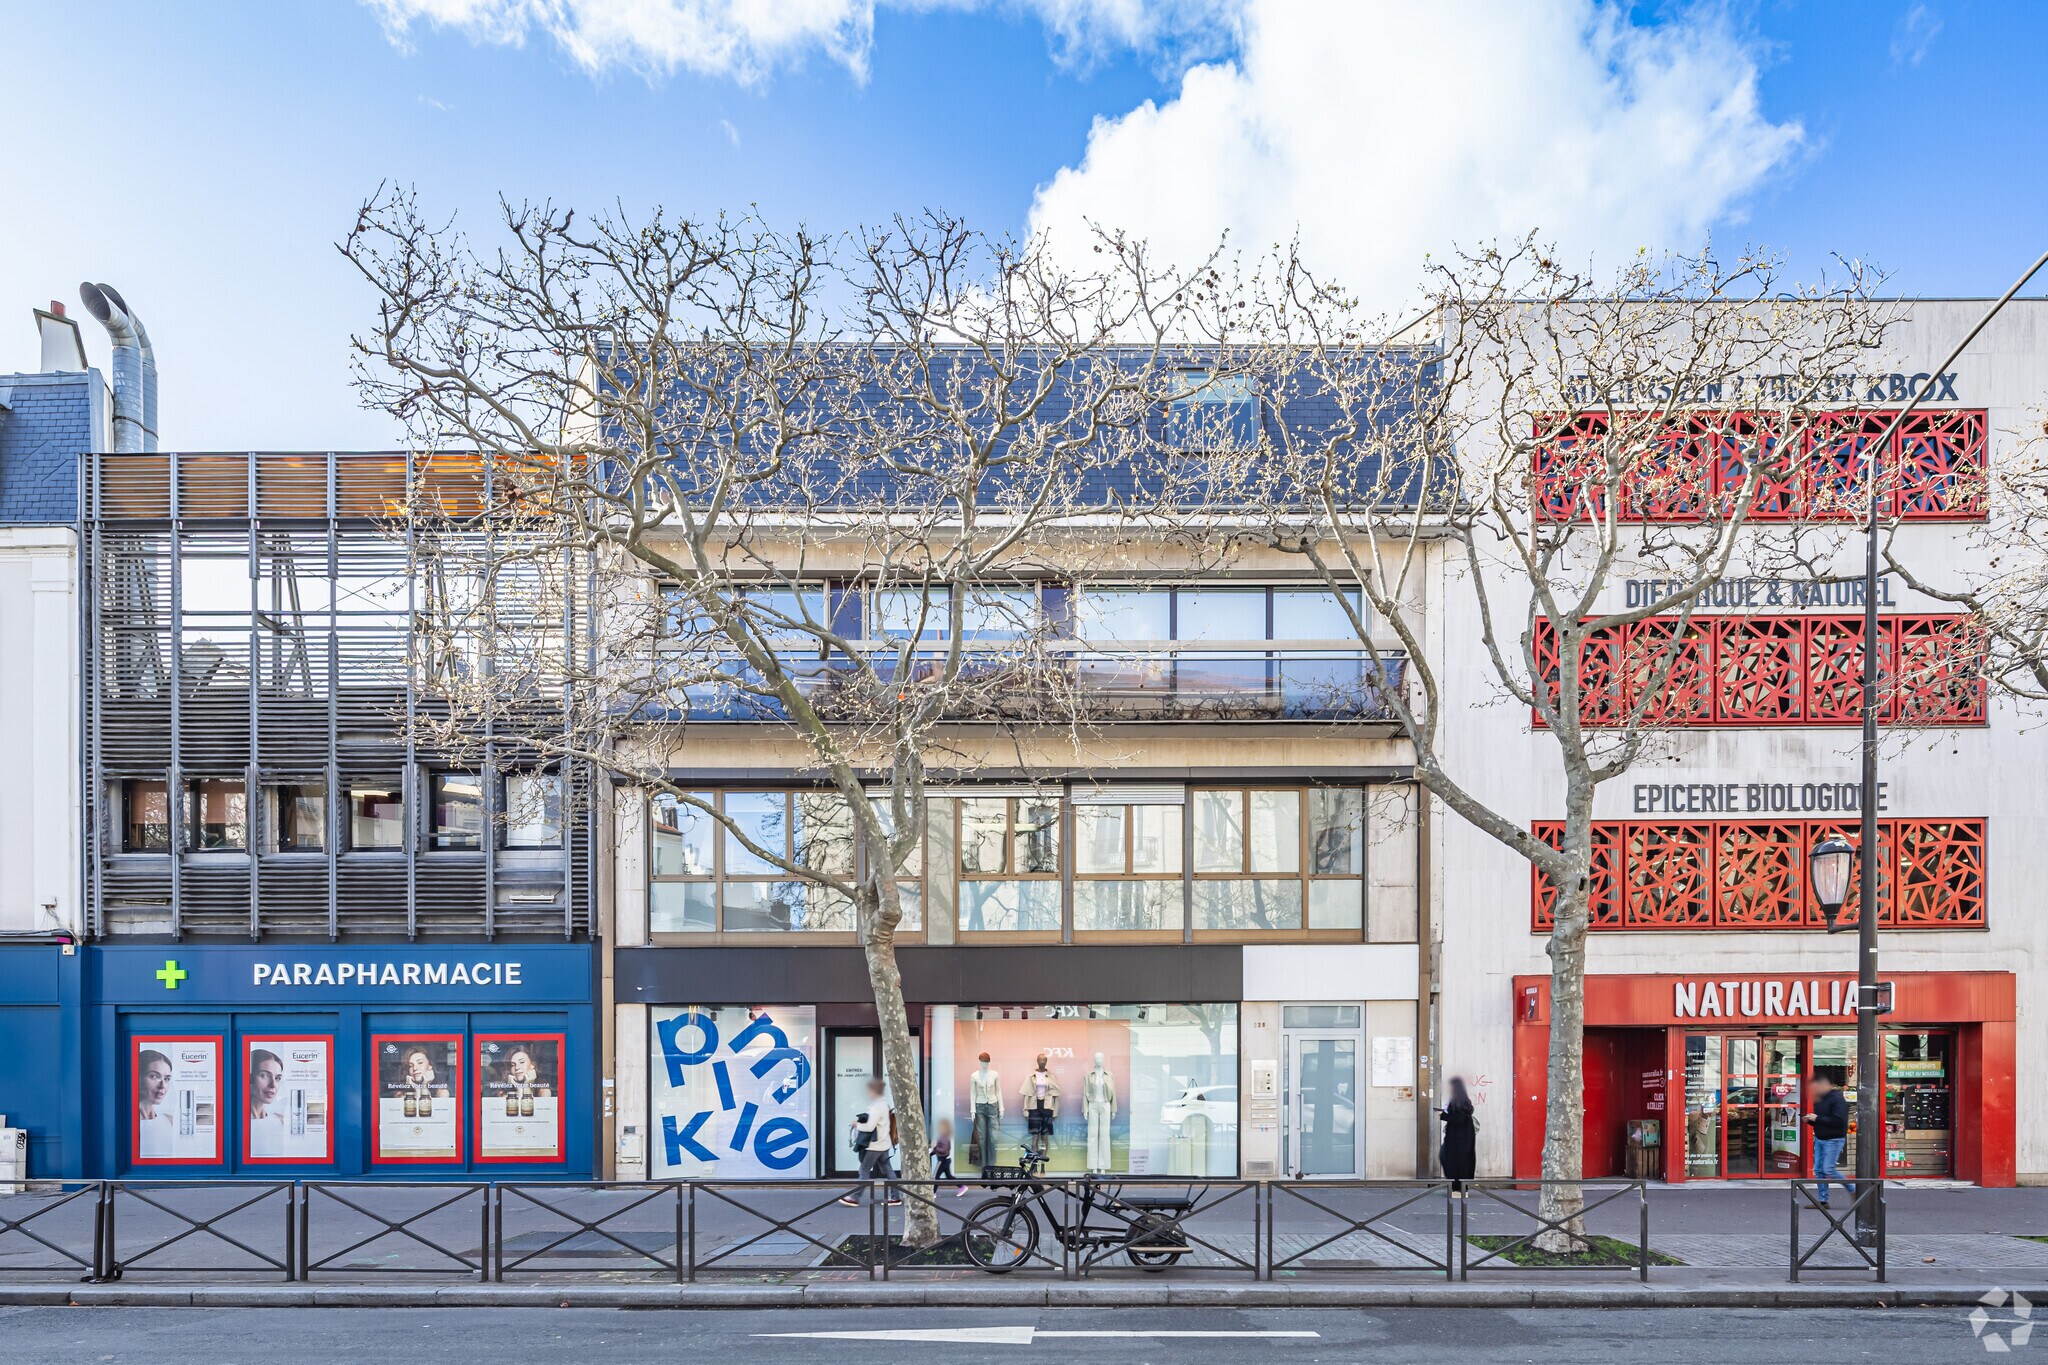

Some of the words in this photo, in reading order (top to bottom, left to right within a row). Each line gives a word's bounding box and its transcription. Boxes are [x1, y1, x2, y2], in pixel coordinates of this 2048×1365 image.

[1867, 372, 1960, 402] KBOX
[1766, 578, 1784, 606] &
[1634, 783, 1739, 813] EPICERIE
[1746, 782, 1888, 812] BIOLOGIQE
[253, 962, 523, 986] PARAPHARMACIE
[181, 1052, 207, 1060] Eucerin
[292, 1052, 318, 1060] Eucerin
[1654, 1093, 1664, 1101] CLICK
